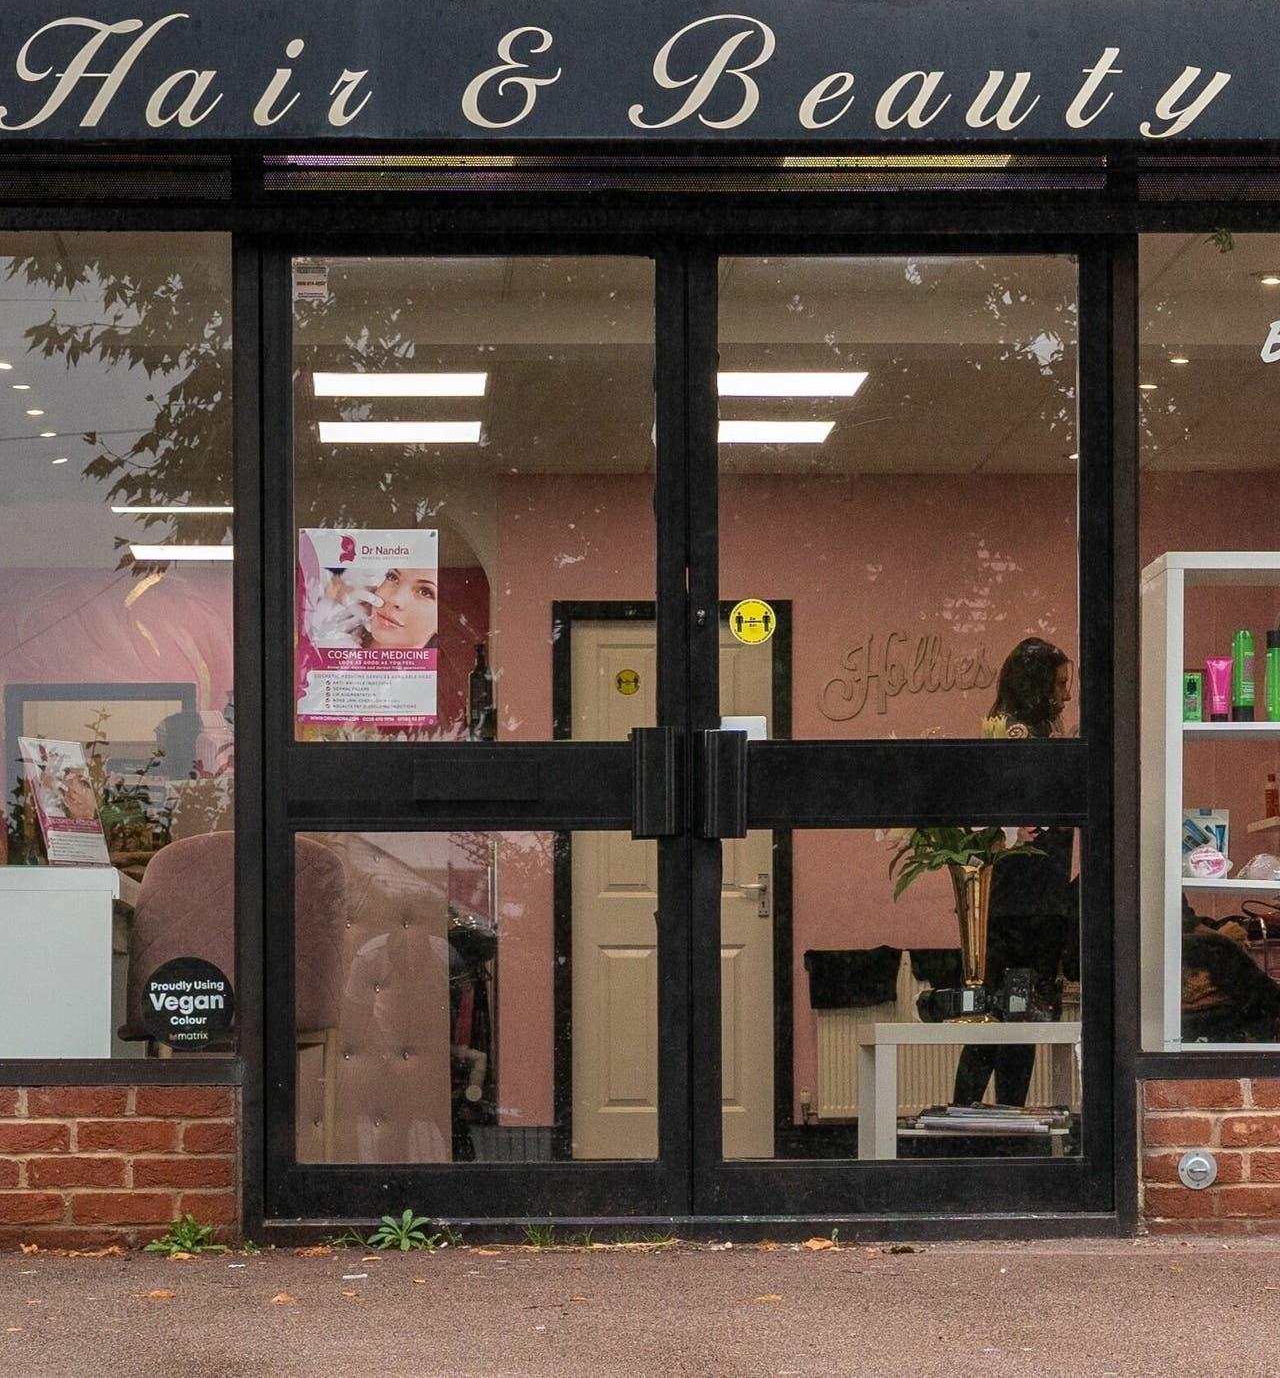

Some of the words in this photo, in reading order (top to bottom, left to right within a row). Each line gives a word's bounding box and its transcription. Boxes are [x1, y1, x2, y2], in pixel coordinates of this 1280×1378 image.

[460, 26, 563, 130] &
[627, 13, 1234, 139] Beauty
[361, 545, 374, 555] Dr
[375, 545, 409, 555] Nandra
[327, 650, 378, 660] COSMETIC
[381, 650, 430, 660] MEDICINE
[150, 980, 192, 992] Proudly
[193, 979, 224, 991] Using
[149, 992, 224, 1015] Vegan
[170, 1015, 208, 1026] Colour
[177, 1030, 209, 1041] matrix
